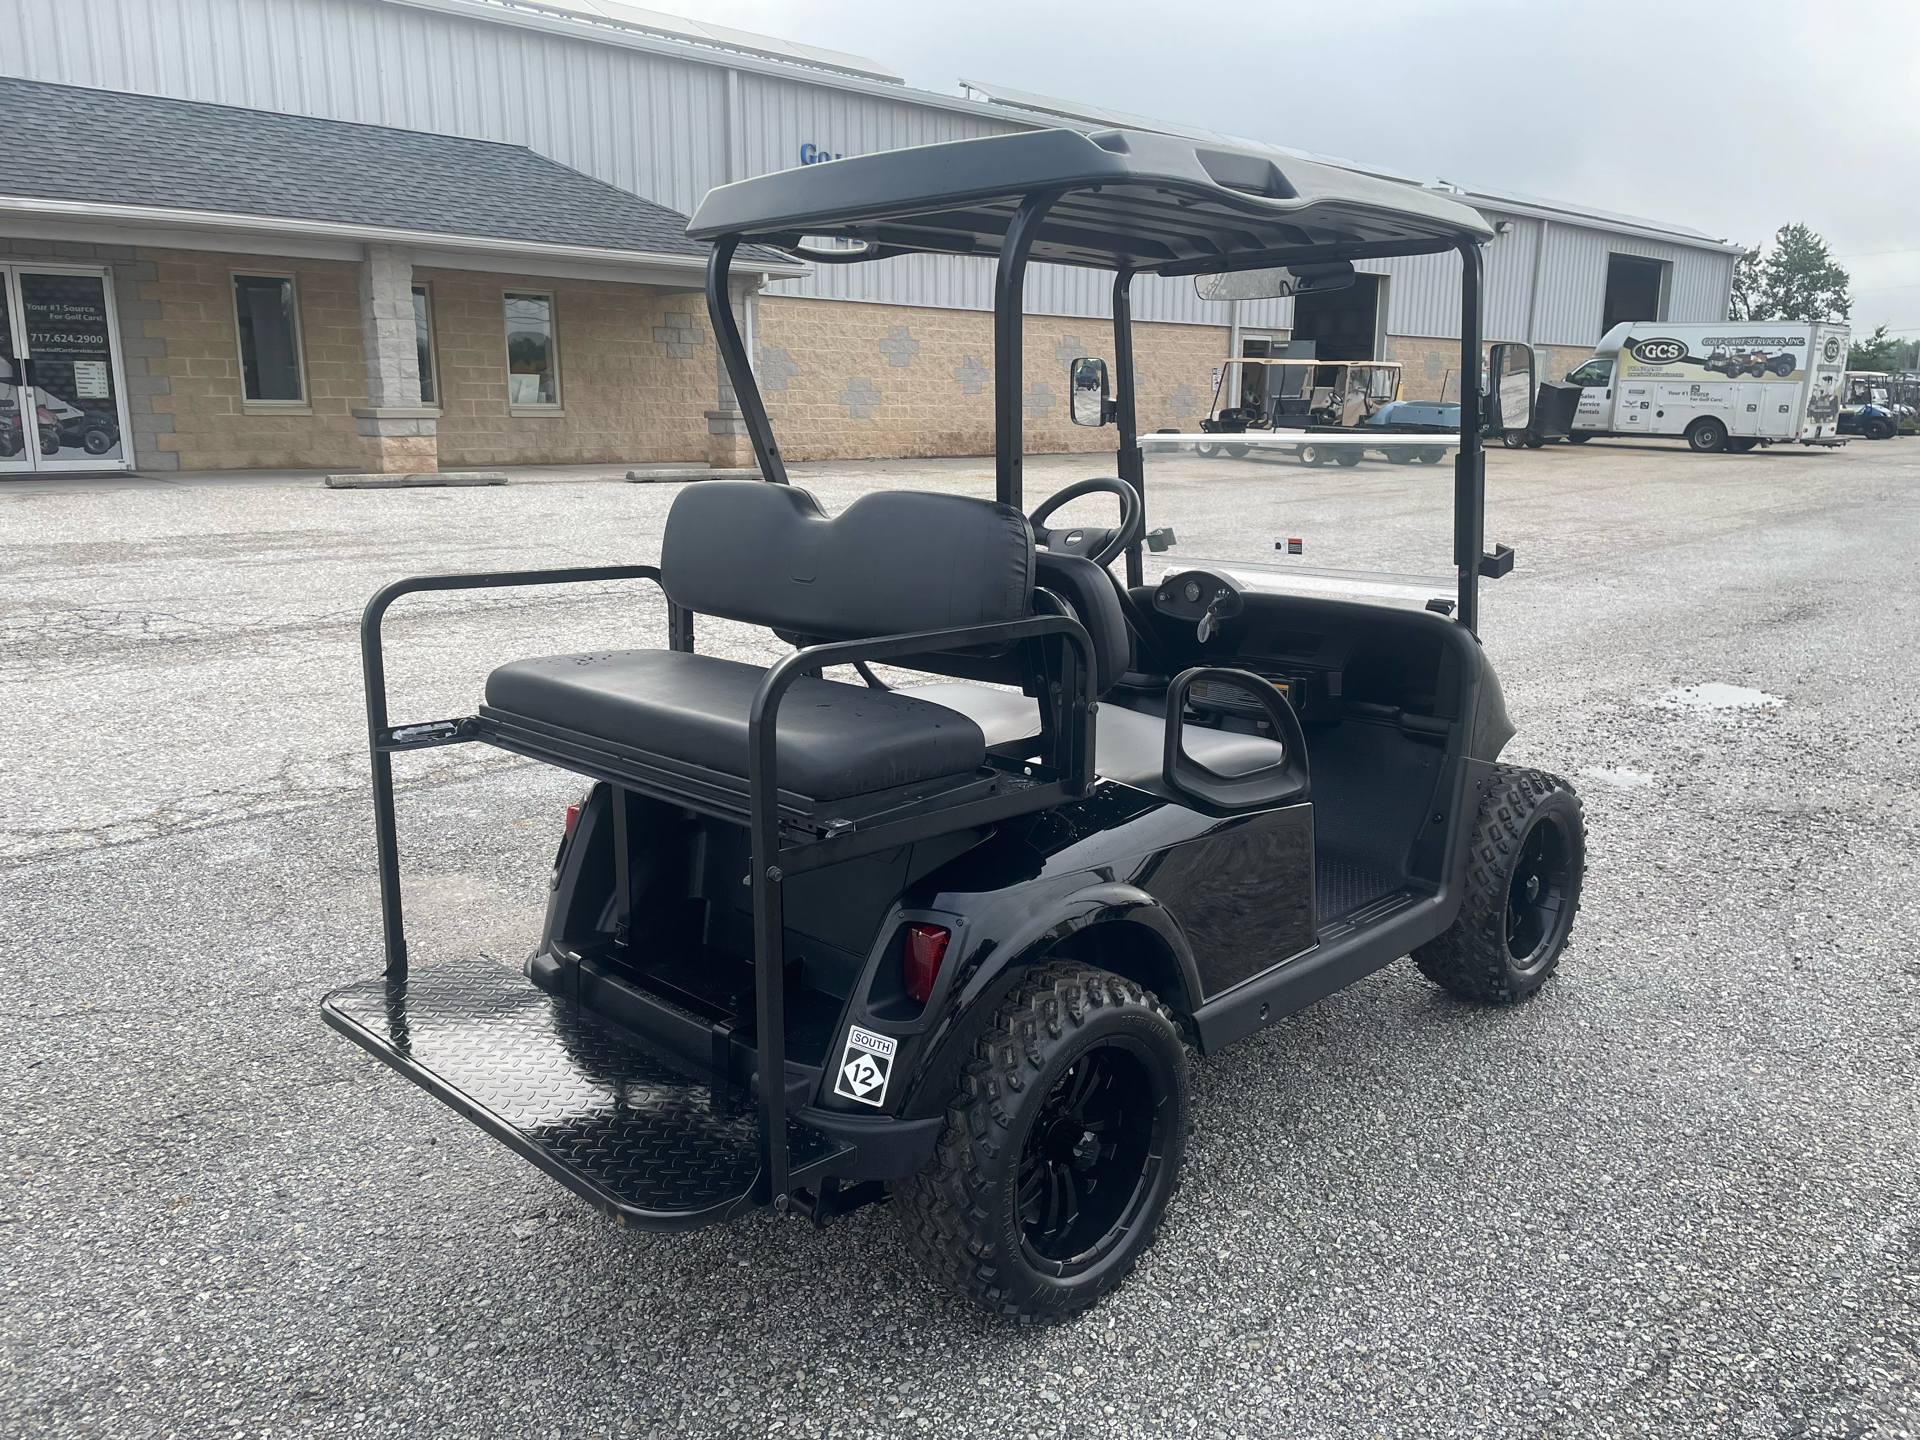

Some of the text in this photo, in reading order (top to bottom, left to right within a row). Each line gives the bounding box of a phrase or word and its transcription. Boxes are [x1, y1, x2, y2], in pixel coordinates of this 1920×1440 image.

[26, 303, 47, 311] Your
[30, 333, 103, 343] 717.624.2900
[1645, 344, 1679, 358] GCS
[854, 1033, 891, 1052] SOUTH
[852, 1063, 875, 1087] 12
